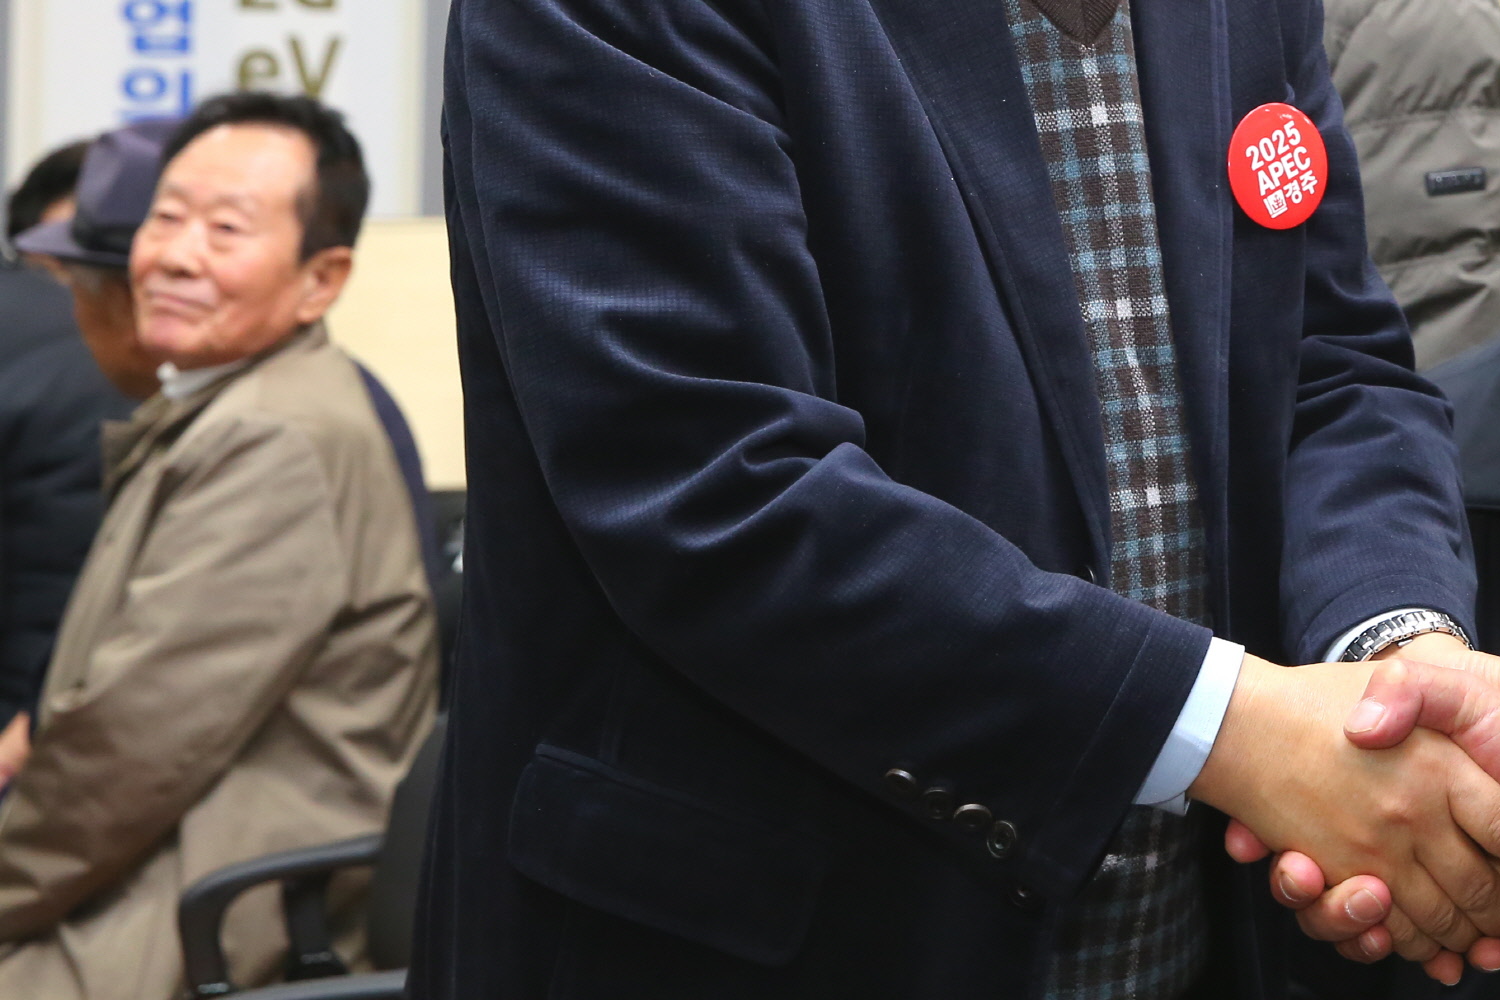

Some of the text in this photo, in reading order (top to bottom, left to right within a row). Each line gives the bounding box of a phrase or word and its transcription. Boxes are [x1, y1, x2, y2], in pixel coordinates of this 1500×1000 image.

[1245, 120, 1301, 171] 2025
[1257, 146, 1311, 196] APEC
[1283, 170, 1318, 204] 경주
